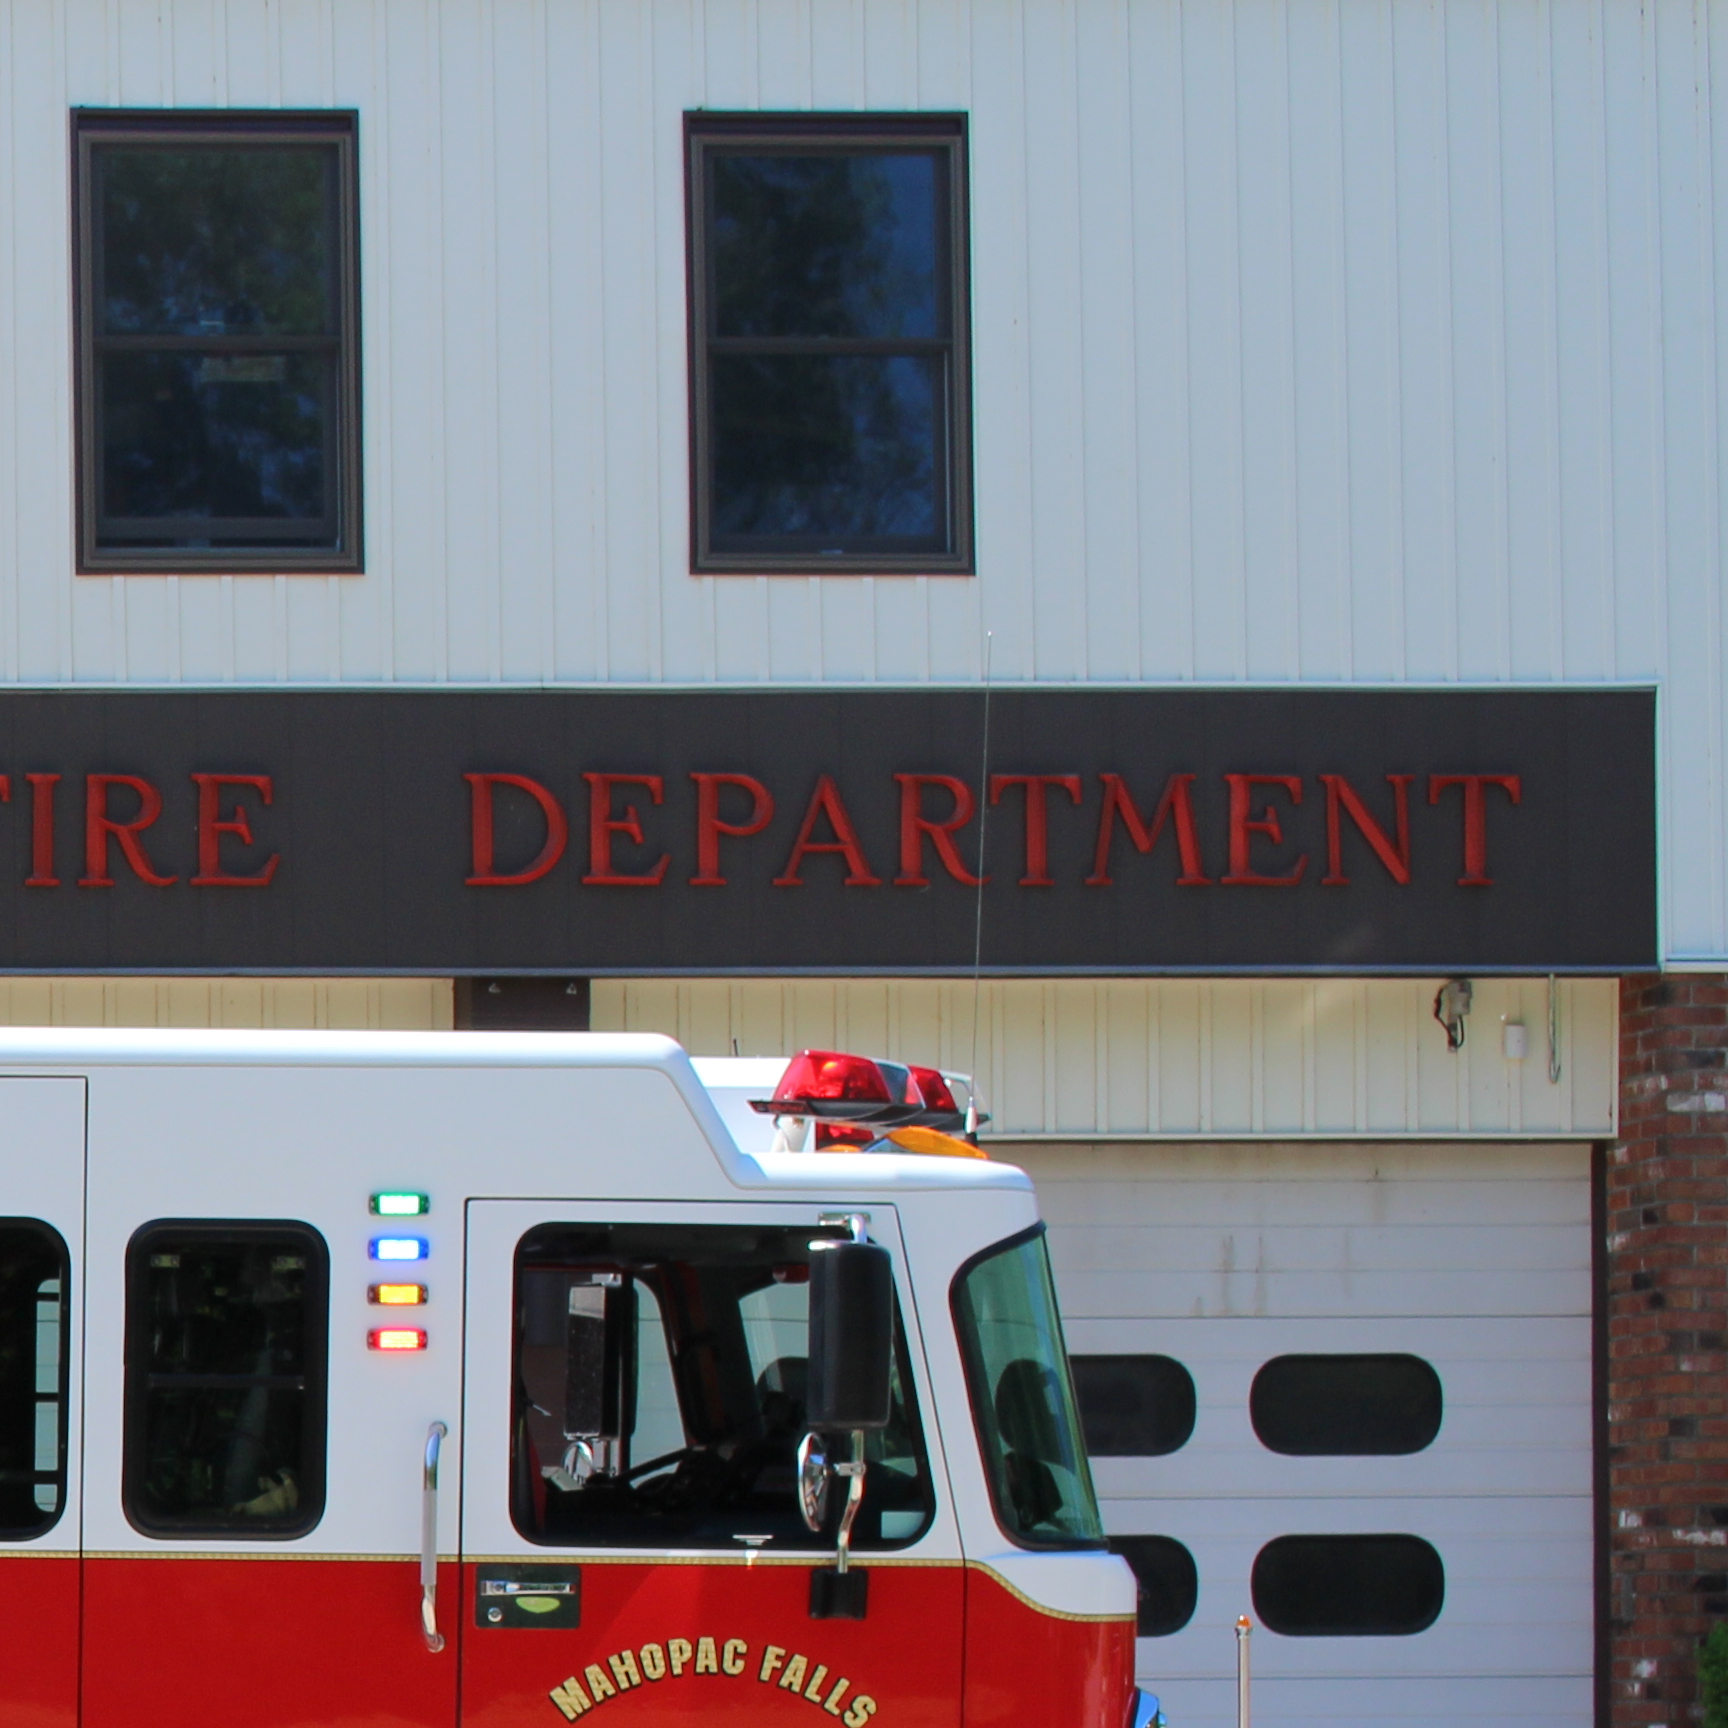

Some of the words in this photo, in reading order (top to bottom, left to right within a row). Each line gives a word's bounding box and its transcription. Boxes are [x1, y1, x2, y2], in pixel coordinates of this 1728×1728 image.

[462, 771, 1522, 886] DEPARTMENT
[549, 1637, 748, 1722] MAHOPAC
[759, 1645, 878, 1728] FALLS
